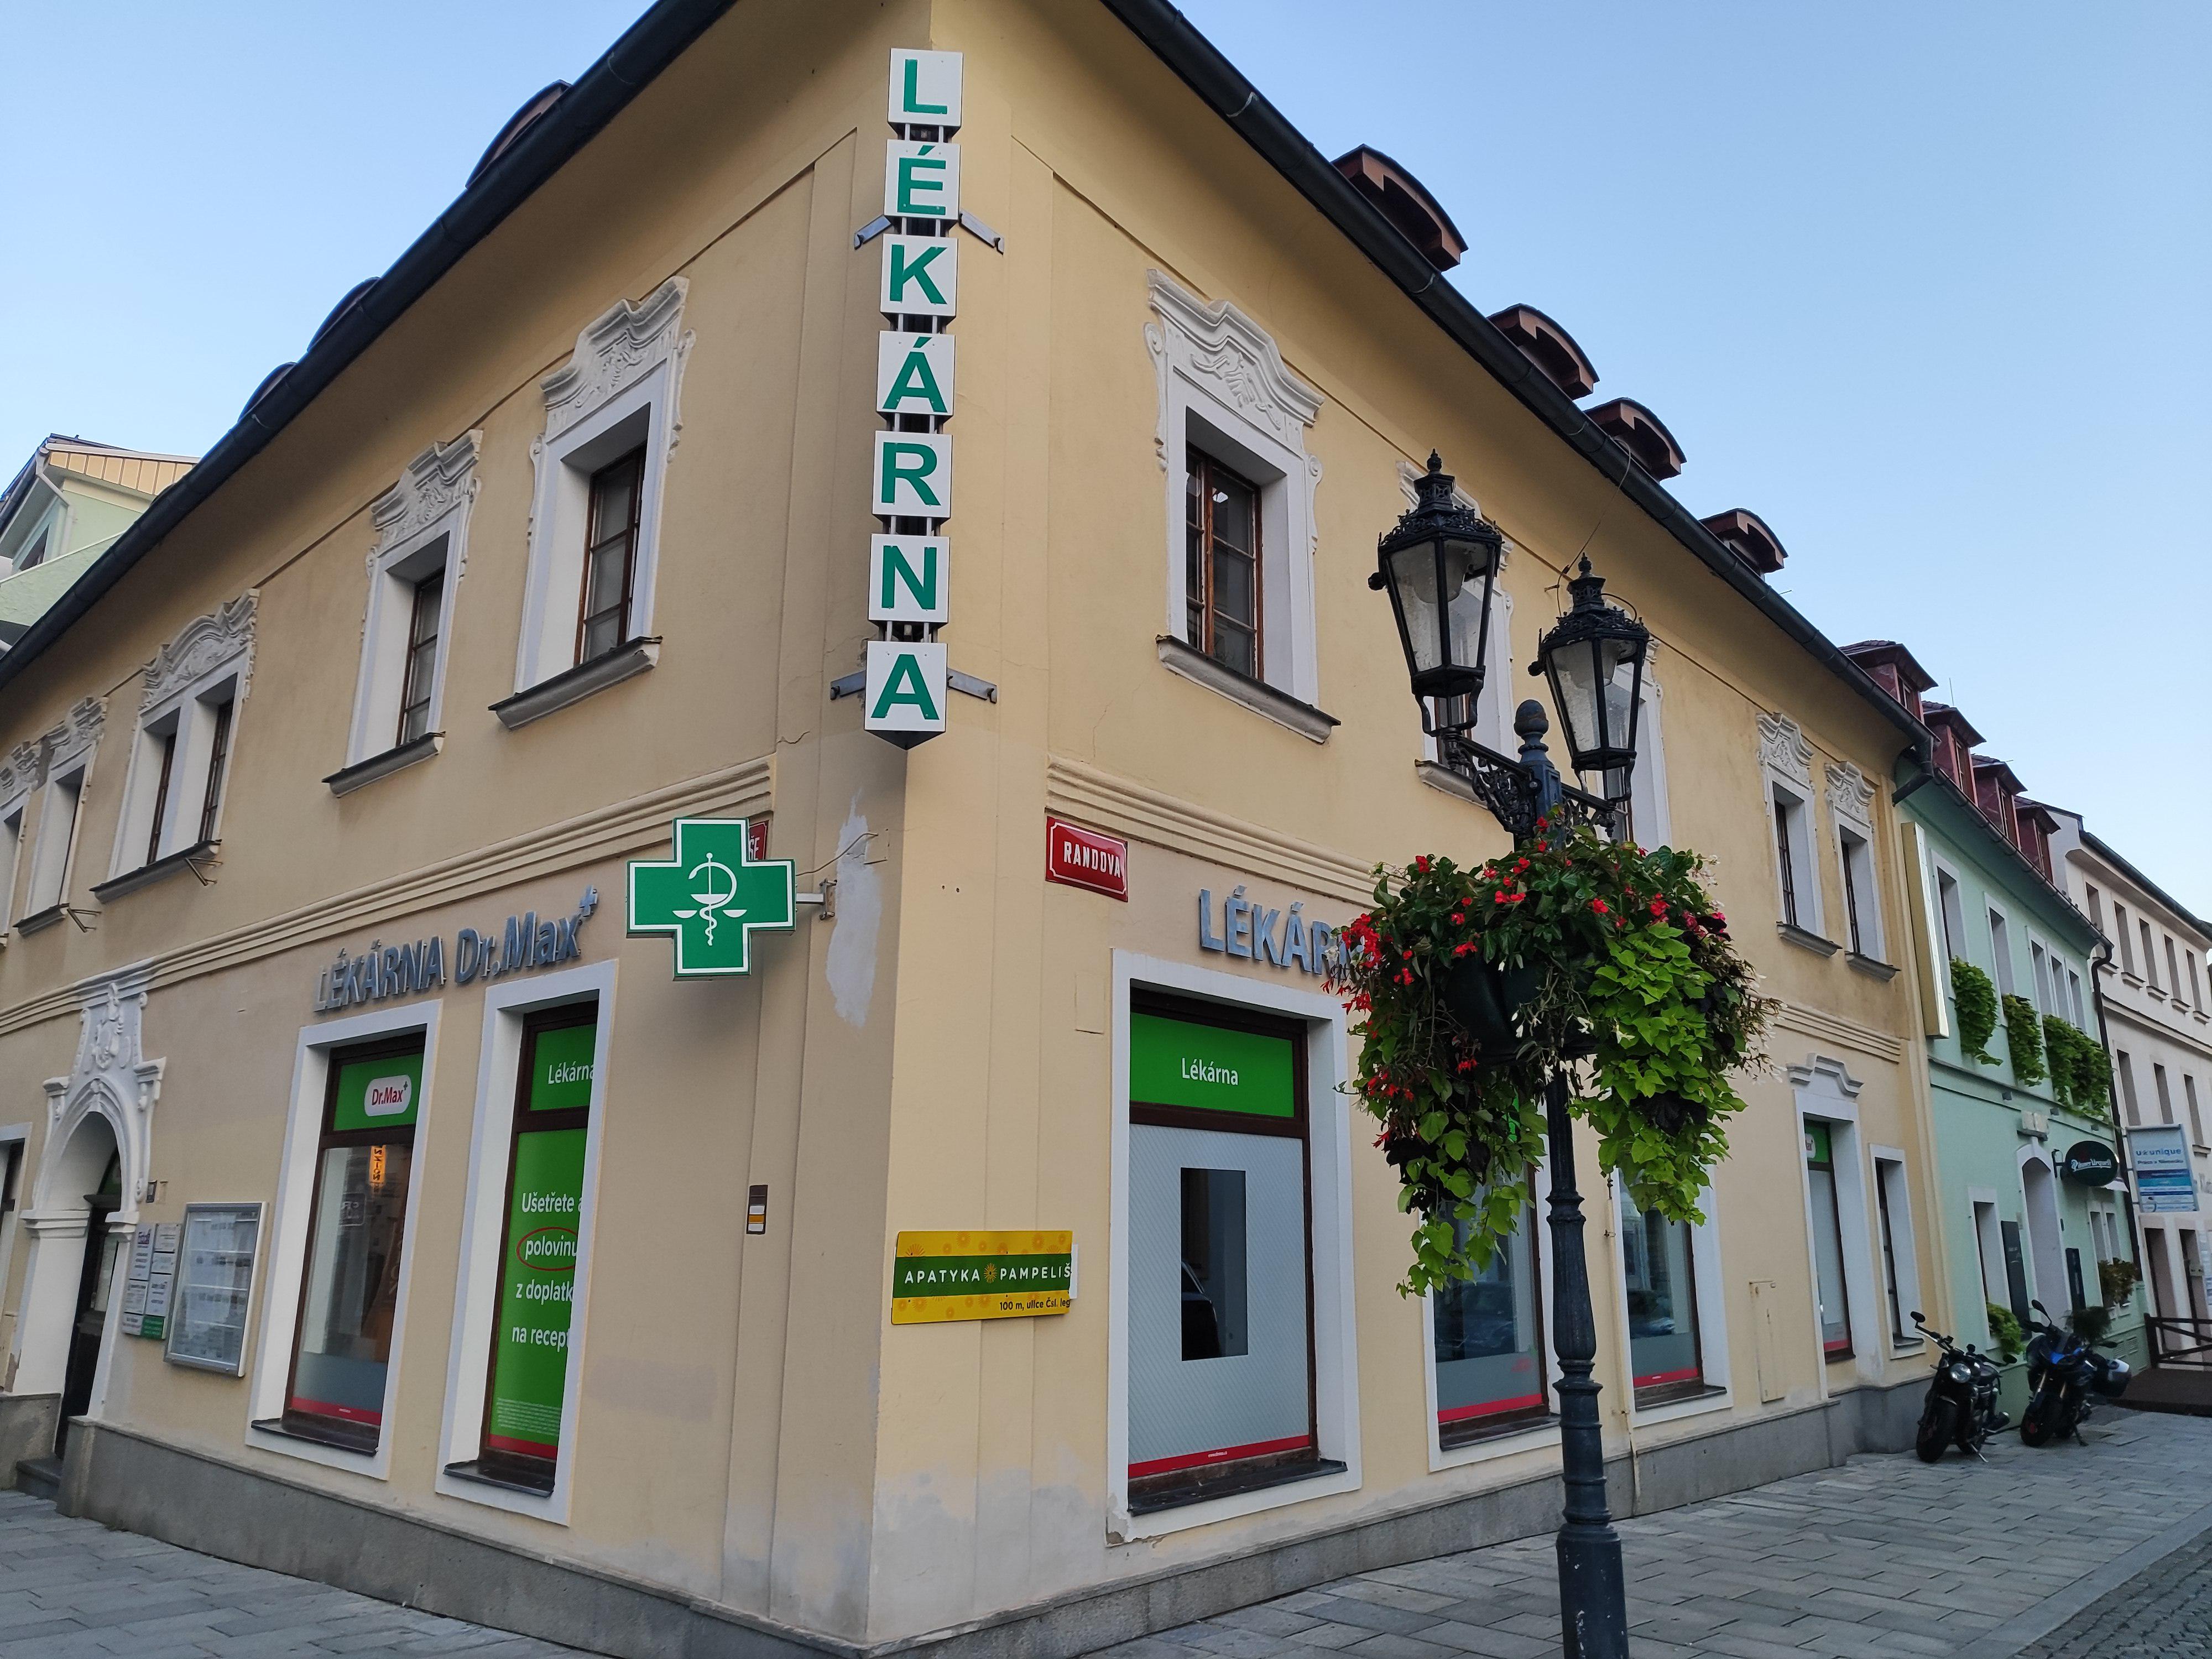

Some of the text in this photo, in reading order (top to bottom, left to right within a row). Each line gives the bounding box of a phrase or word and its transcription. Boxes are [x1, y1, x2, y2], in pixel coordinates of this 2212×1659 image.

[870, 59, 948, 720] LÉKÁRNA
[1063, 841, 1121, 878] RANDOVA
[314, 910, 582, 1012] LÉKÁRNA Dr.Max
[1182, 1057, 1238, 1086] Lékárna
[371, 1086, 404, 1105] Dr.Max
[521, 1191, 575, 1213] Ušetřete
[525, 1234, 577, 1260] polovinu
[904, 1262, 1071, 1284] APATYKA PAMPELIŠ
[515, 1279, 574, 1305] z doplatk
[999, 1301, 1013, 1311] 100
[1026, 1300, 1044, 1309] ulice
[512, 1327, 527, 1343] na
